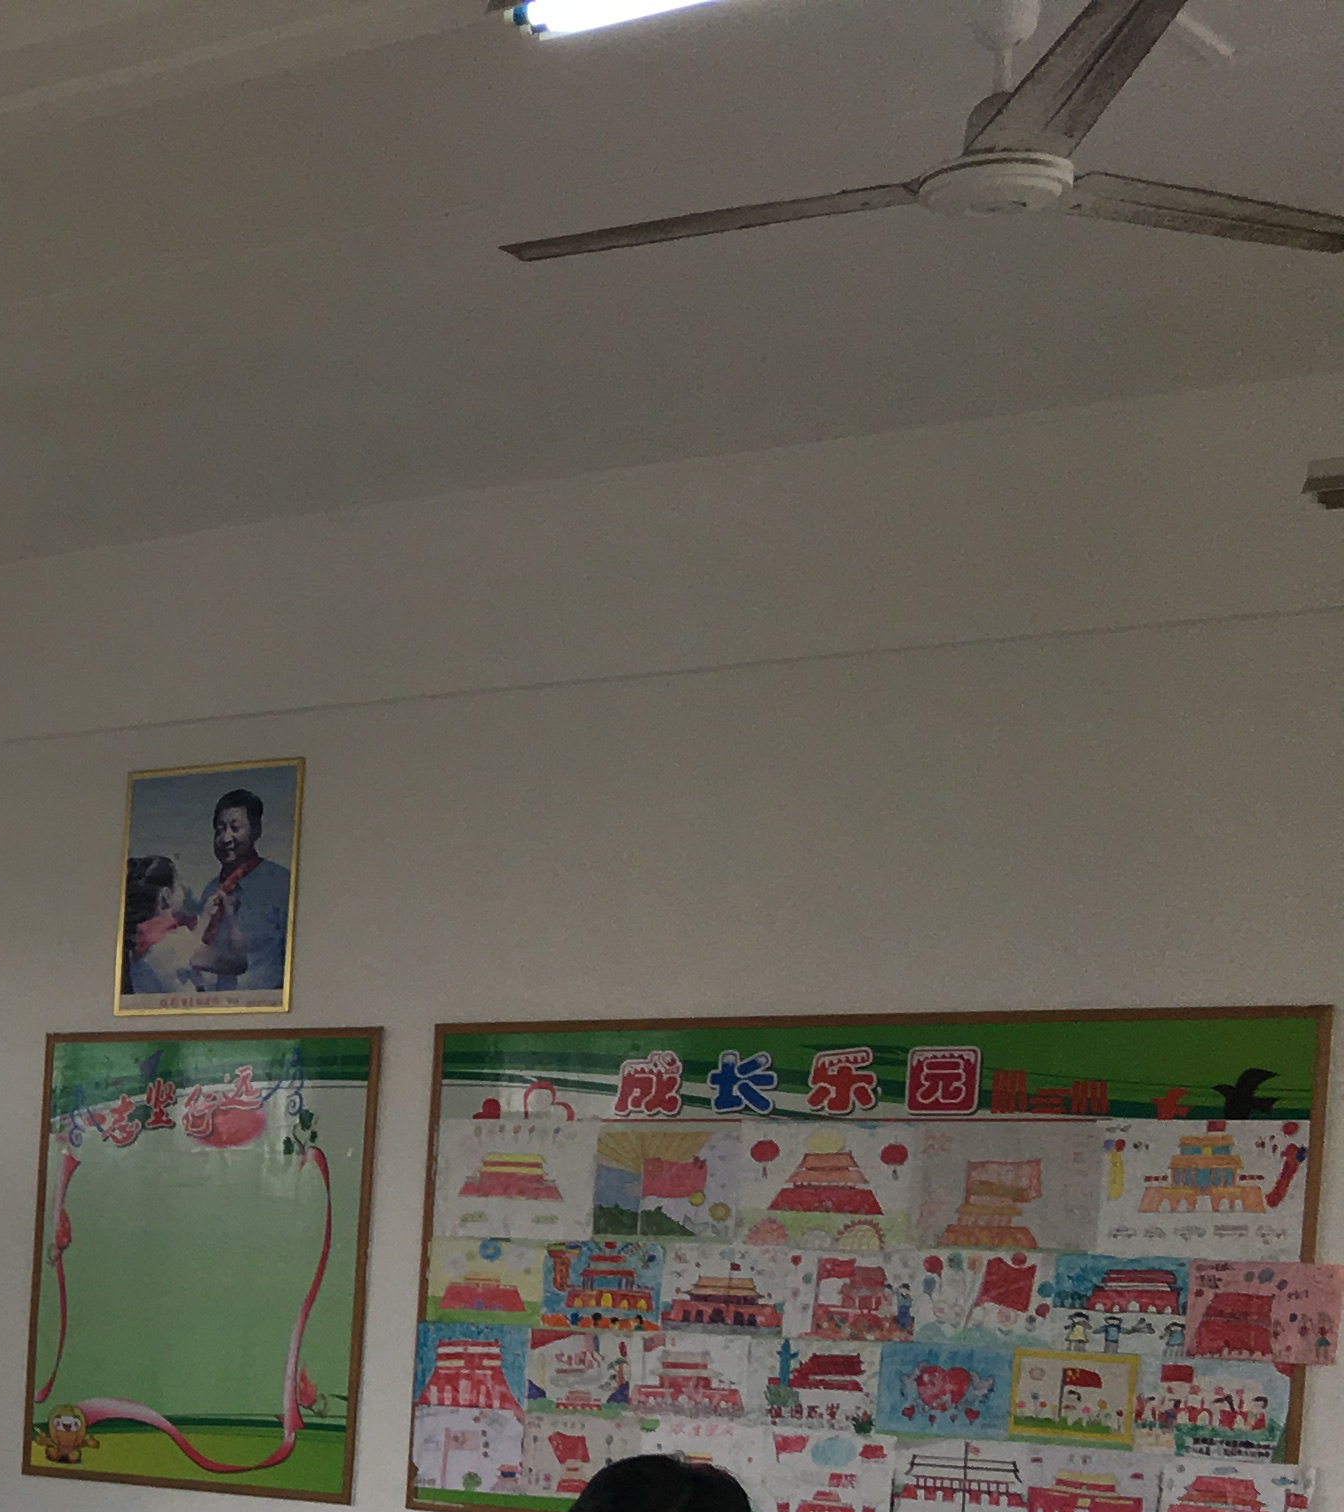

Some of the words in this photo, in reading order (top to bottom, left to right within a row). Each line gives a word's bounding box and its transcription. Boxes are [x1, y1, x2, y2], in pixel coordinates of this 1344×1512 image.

[102, 1064, 263, 1148] 志坚行远
[614, 1046, 982, 1116] 成长乐园
